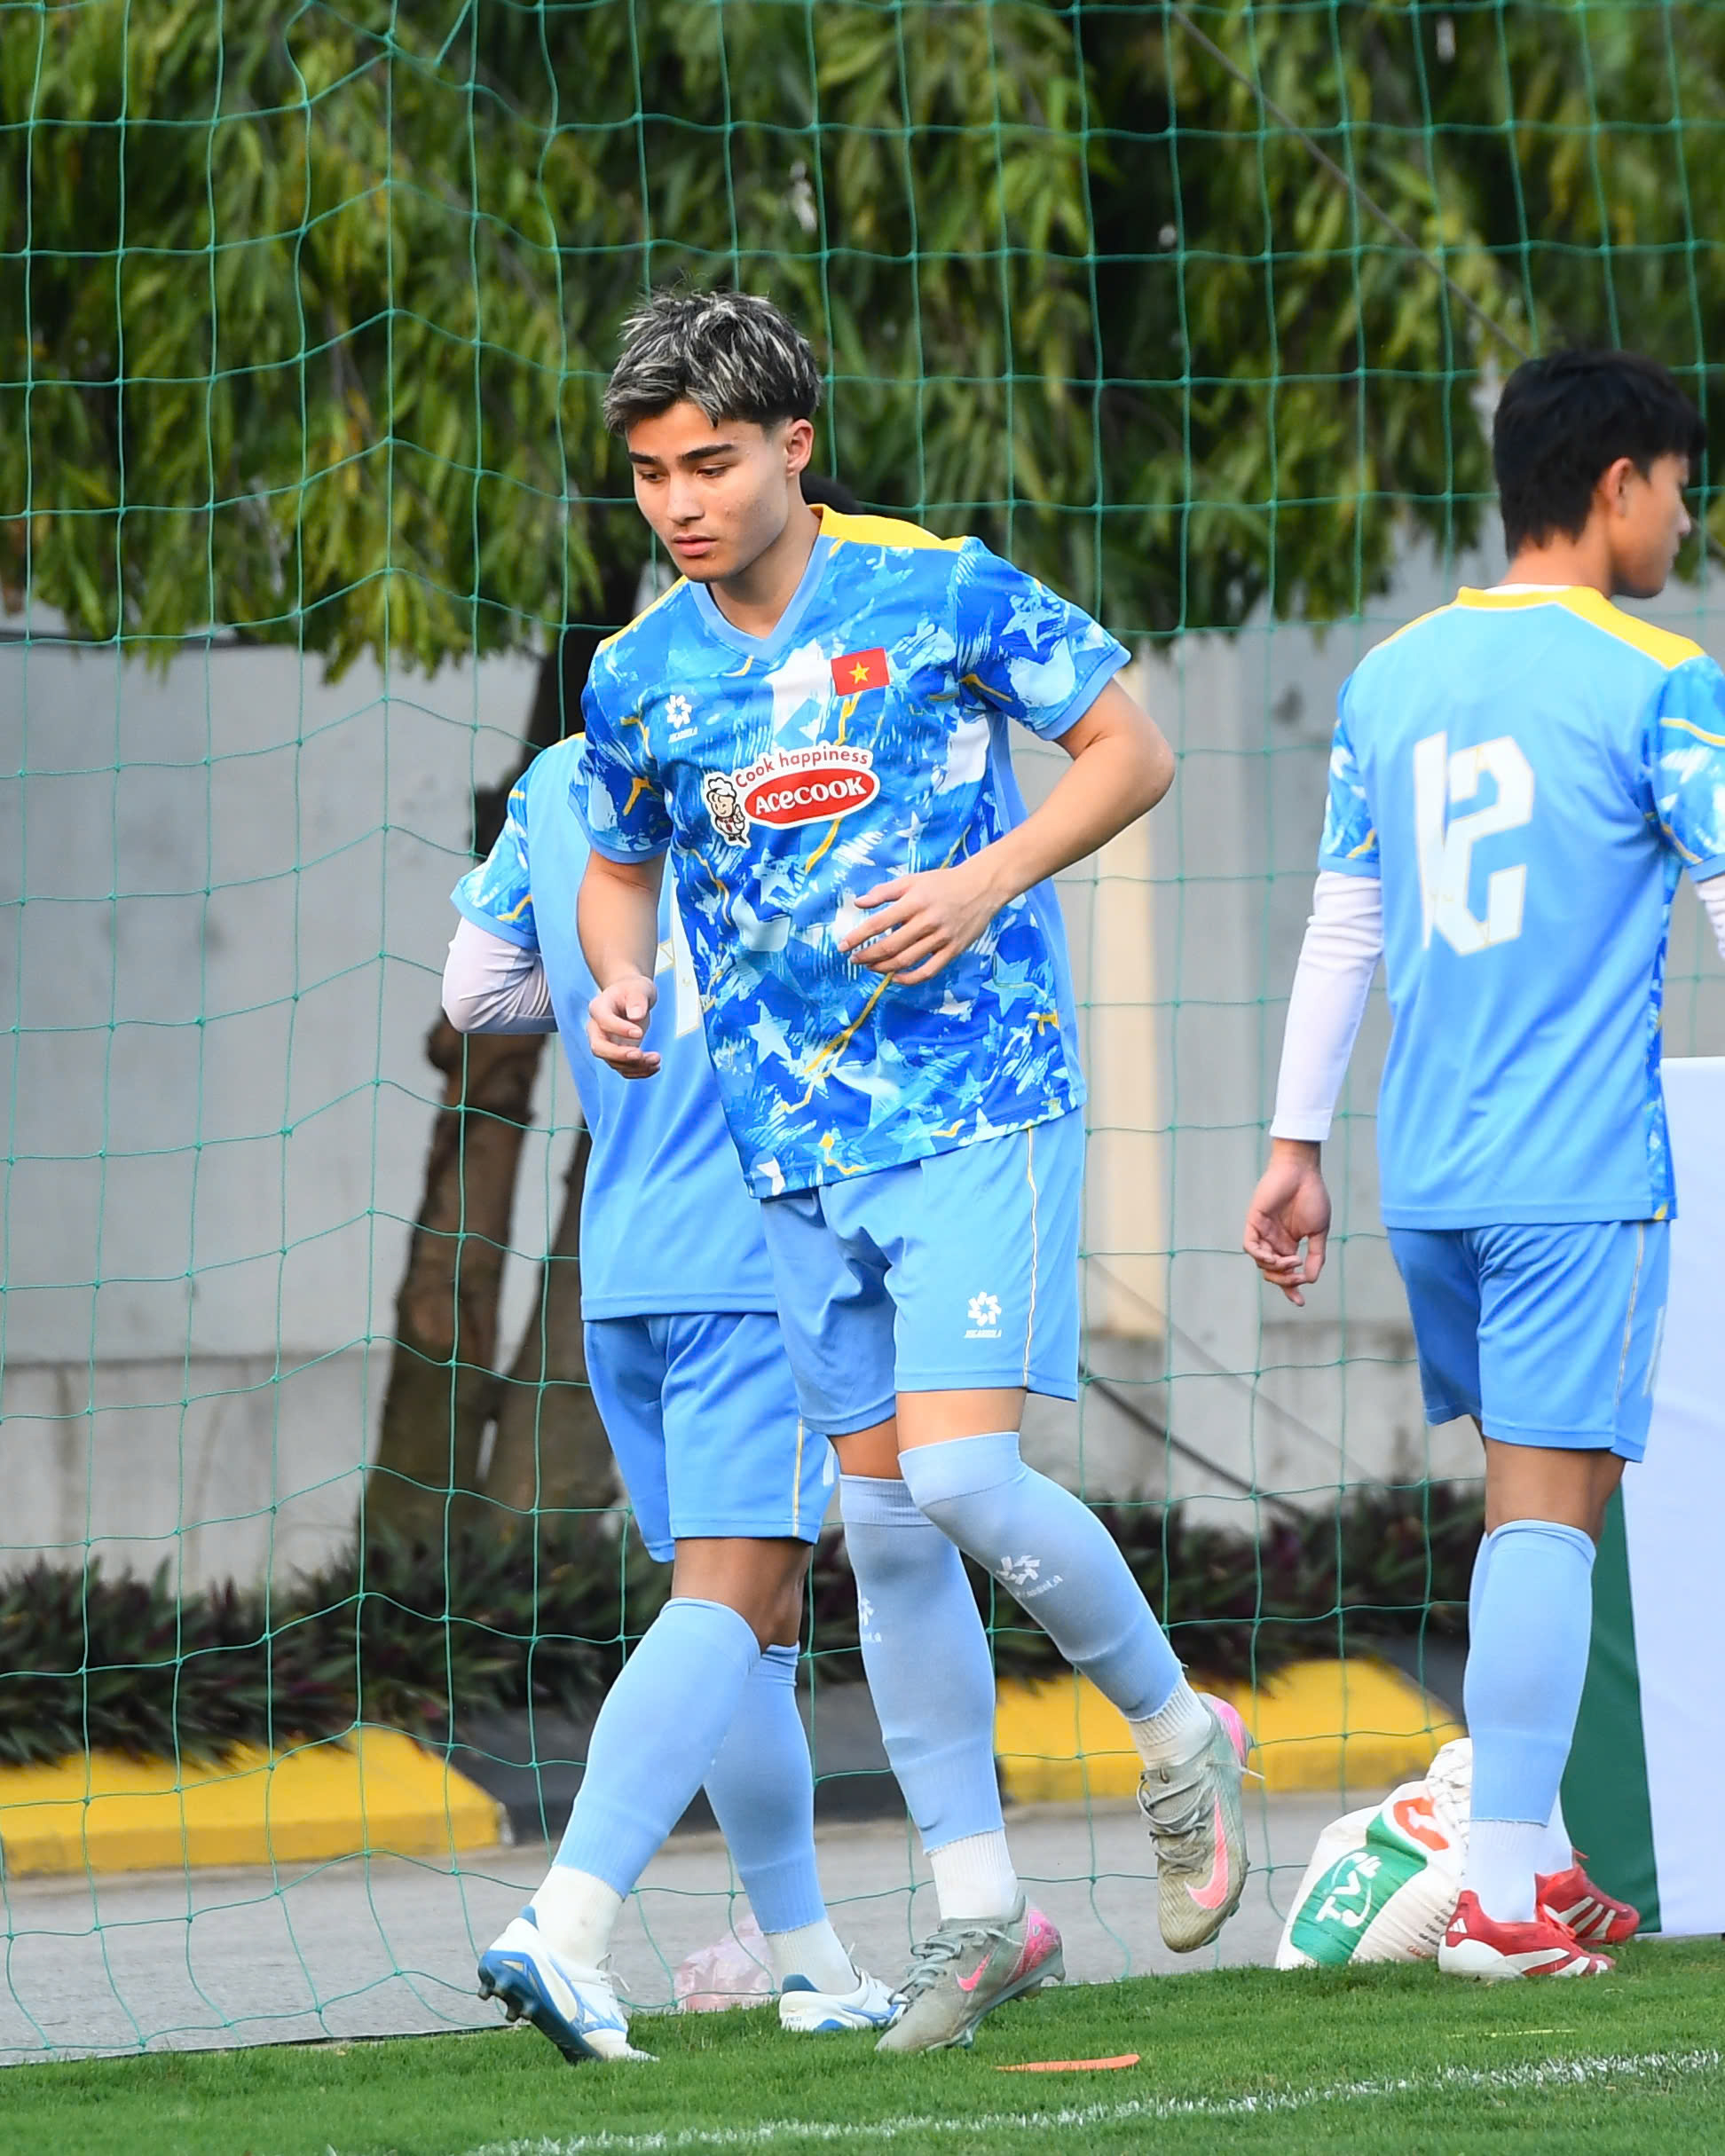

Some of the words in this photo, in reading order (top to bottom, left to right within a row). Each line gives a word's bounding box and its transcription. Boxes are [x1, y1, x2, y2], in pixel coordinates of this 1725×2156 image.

[736, 758, 775, 788] Cook
[779, 746, 868, 768] happiness
[1414, 729, 1535, 956] 12
